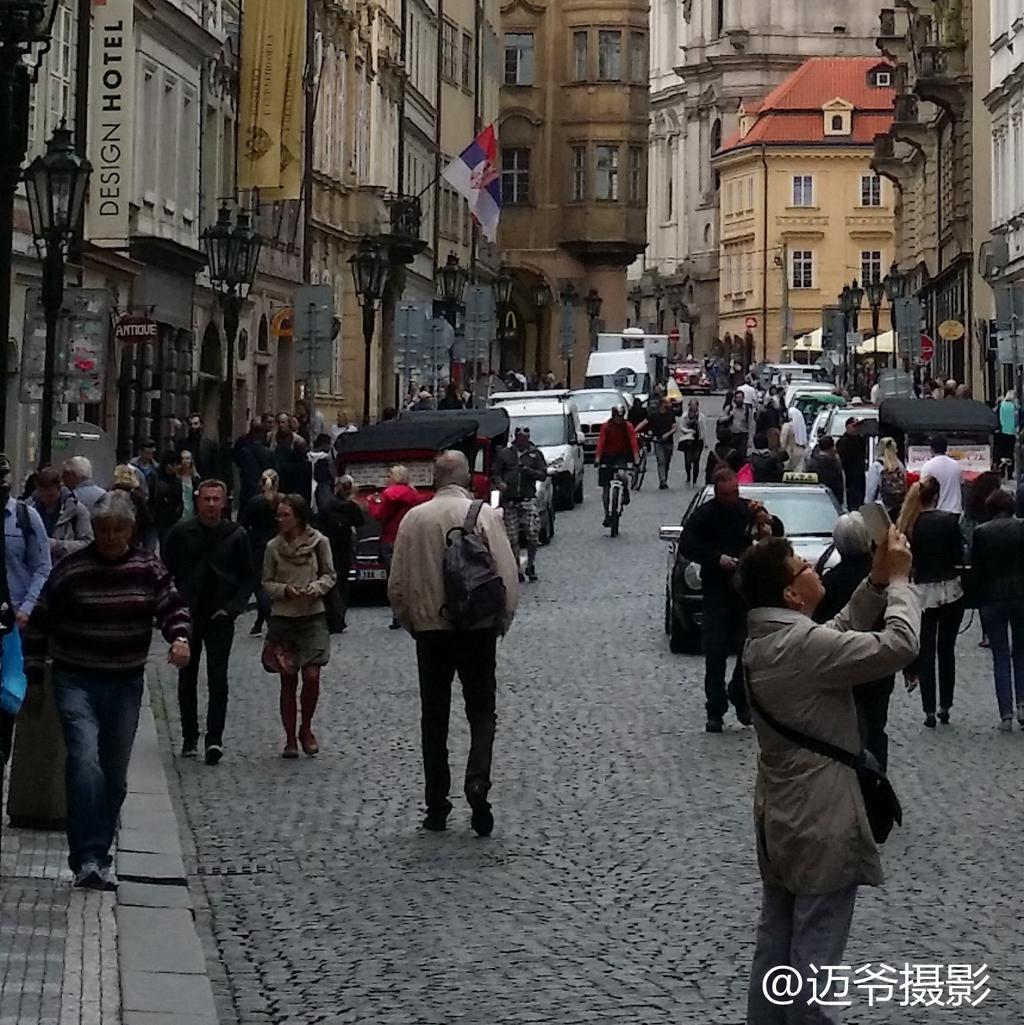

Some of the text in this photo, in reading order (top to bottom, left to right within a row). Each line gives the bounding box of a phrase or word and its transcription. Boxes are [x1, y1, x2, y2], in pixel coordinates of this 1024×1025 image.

[99, 20, 123, 216] DESIGN HOTEL
[115, 324, 157, 336] ANTIQUE
